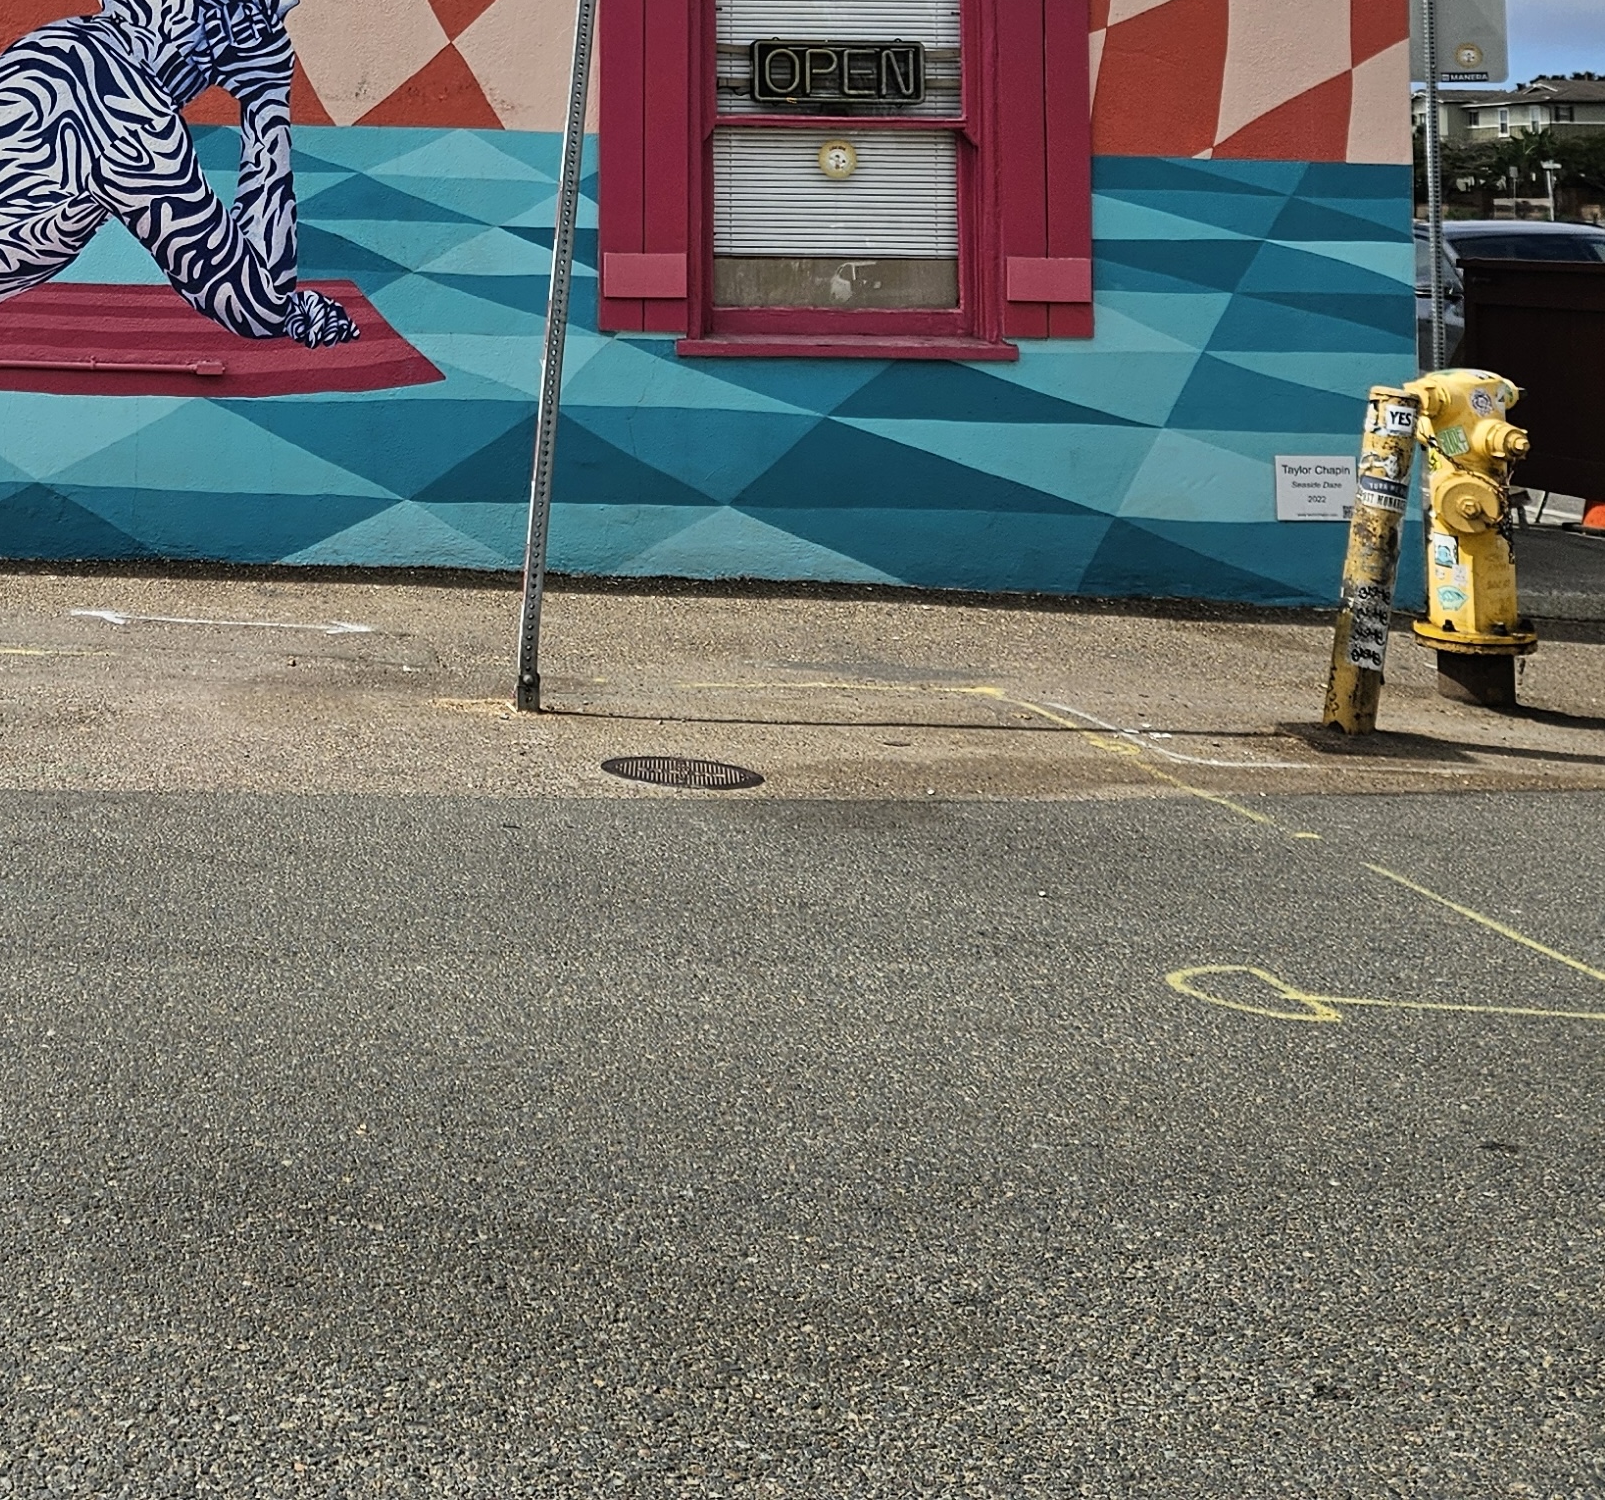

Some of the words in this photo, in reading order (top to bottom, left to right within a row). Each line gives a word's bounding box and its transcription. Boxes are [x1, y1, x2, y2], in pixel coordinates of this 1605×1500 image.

[764, 47, 915, 97] OPEN
[1390, 411, 1412, 426] YES
[1281, 464, 1312, 476] Taylor
[1314, 465, 1351, 476] Chapin
[1291, 481, 1322, 489] Seaside
[1322, 481, 1343, 489] Daze
[1308, 495, 1327, 503] 2022
